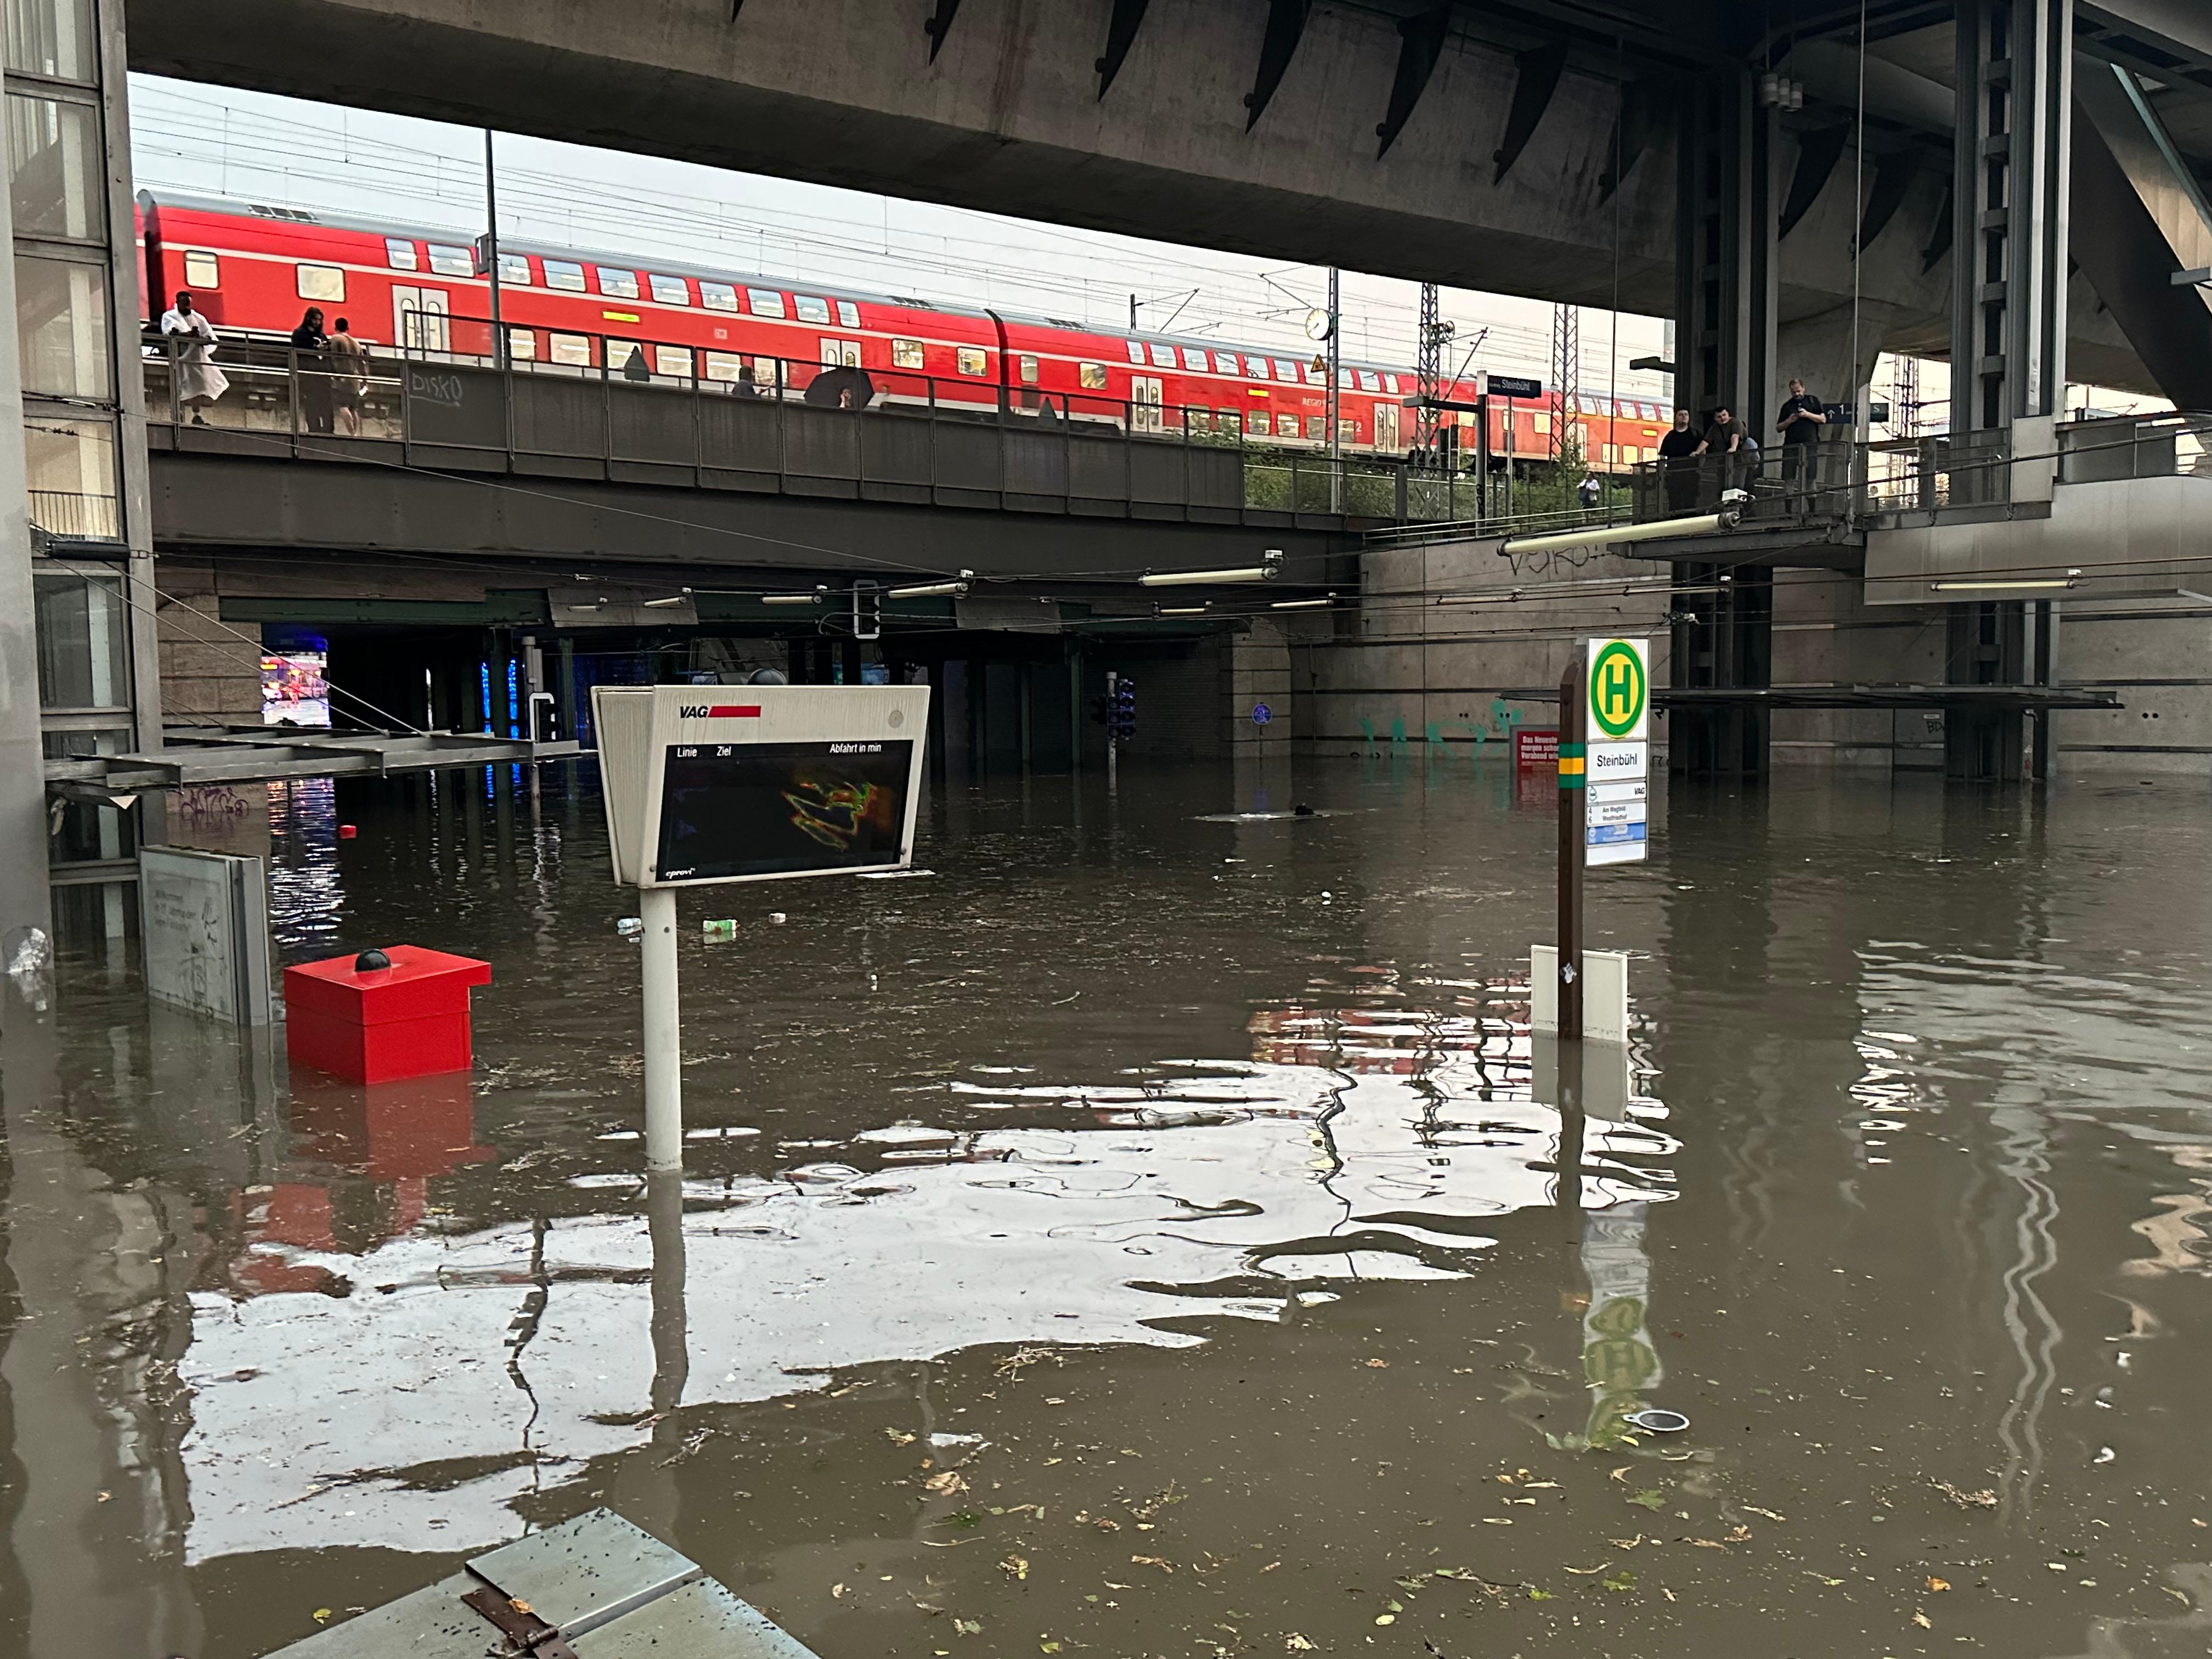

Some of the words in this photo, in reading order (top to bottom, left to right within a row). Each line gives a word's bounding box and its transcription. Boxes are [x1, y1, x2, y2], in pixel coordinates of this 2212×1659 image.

[476, 238, 482, 264] 1
[412, 373, 462, 400] DISKO
[1839, 404, 1844, 415] 1
[1356, 421, 1362, 432] 2
[1605, 664, 1631, 714] H
[680, 706, 708, 719] VAG
[677, 747, 697, 757] Linie
[716, 746, 731, 757] Ziel
[829, 743, 857, 753] Abfahrt
[859, 742, 866, 753] in
[867, 742, 882, 753] min
[1597, 753, 1637, 767] Steinbühl
